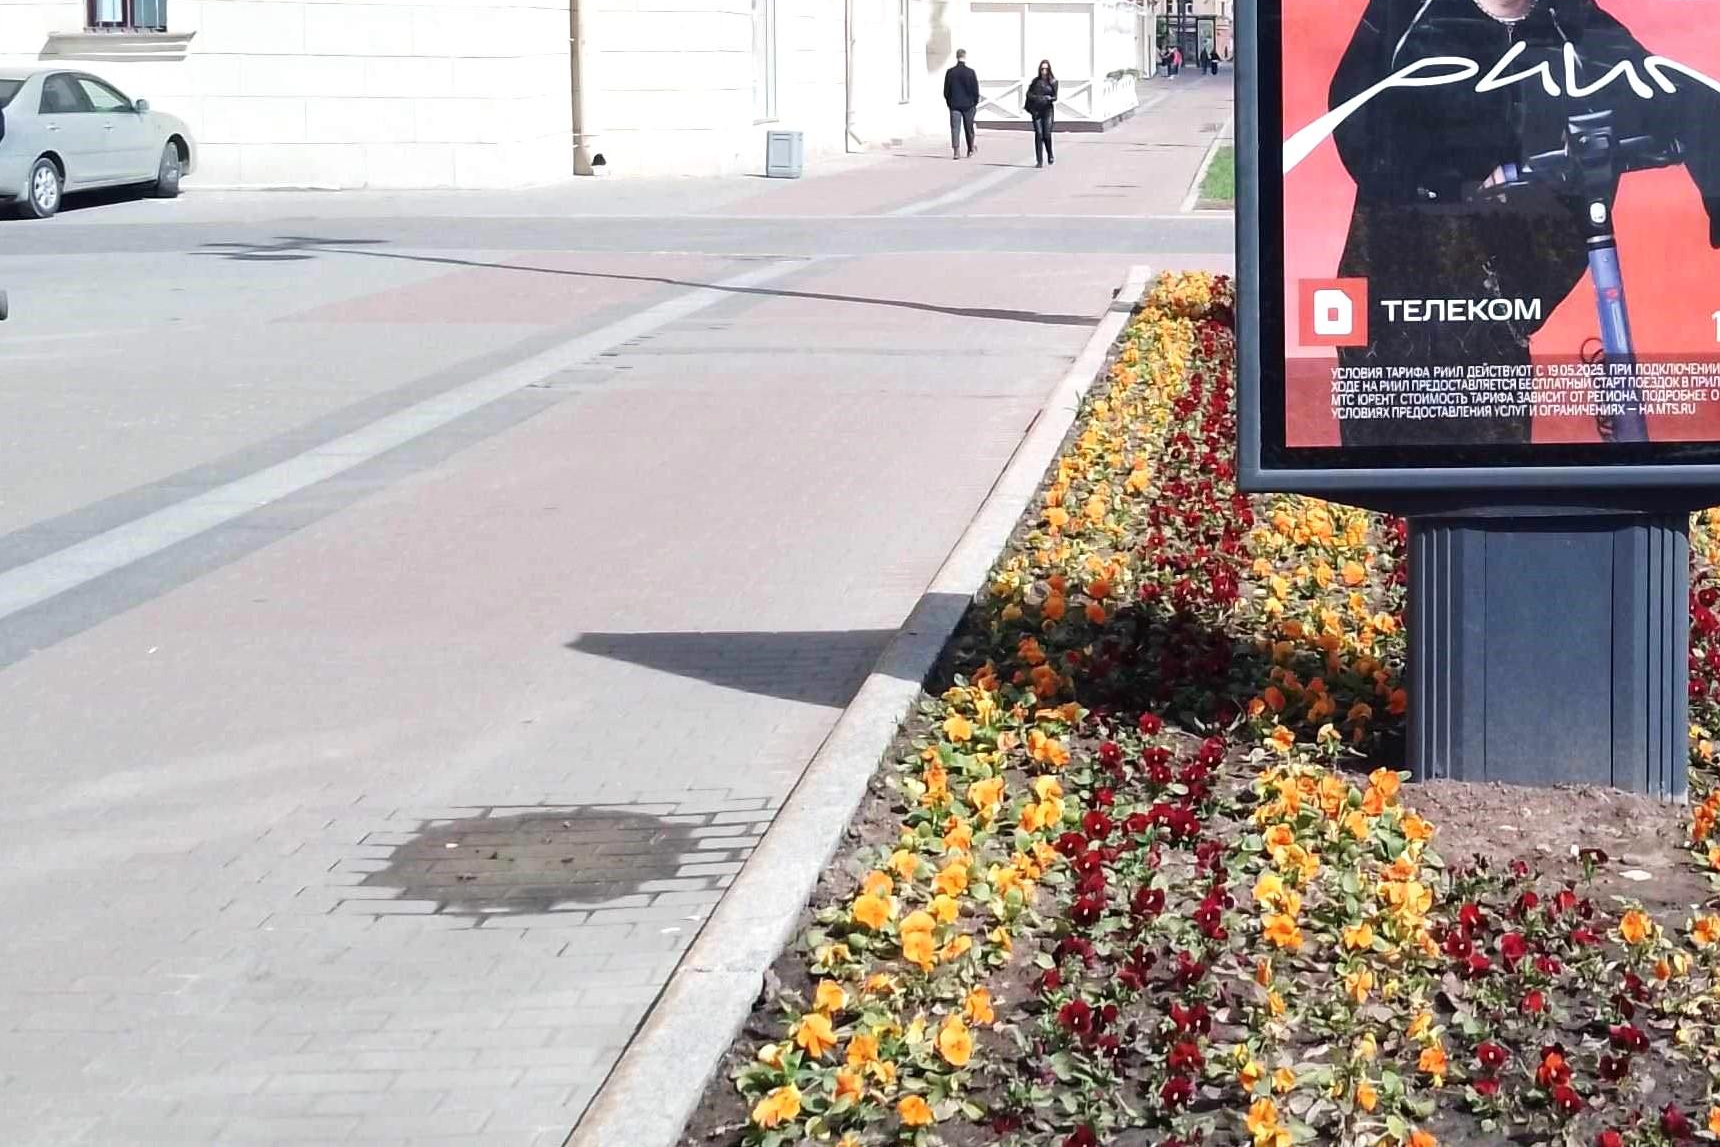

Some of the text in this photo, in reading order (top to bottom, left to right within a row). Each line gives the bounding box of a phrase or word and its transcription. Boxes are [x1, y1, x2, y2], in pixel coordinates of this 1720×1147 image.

[1381, 298, 1541, 322] ТЕЛЕКОМ
[1331, 367, 1383, 379] УСЛОВИЯ
[1386, 366, 1430, 378] ТАРИФА
[1433, 366, 1463, 378] РИИЛ
[1467, 363, 1531, 378] ДЕЙСТВУЮТ
[1536, 365, 1544, 376] С
[1610, 364, 1632, 375] ПРИ
[1636, 363, 1720, 376] ПОДКЛЮЧЕНИИ
[1331, 381, 1360, 393] ХОДЕ
[1362, 381, 1378, 392] НА
[1380, 380, 1409, 392] РИИЛ
[1412, 379, 1516, 391] ПРЕДОСТАВЛЯЕТСЯ
[1518, 377, 1591, 390] БЕСПЛАТНЫЙ
[1593, 377, 1626, 389] СТАРТ
[1628, 376, 1680, 389] ПОЕЗДОК
[1331, 394, 1355, 406] МТС
[1400, 393, 1467, 405] СТОИМОСТЬ
[1470, 392, 1513, 404] ТАРИФА
[1516, 391, 1566, 404] ЗАВИСИТ
[1570, 391, 1584, 402] ОТ
[1642, 390, 1707, 402] ПОДРОБНЕЕ
[1331, 407, 1391, 419] УСЛОВИЯХ
[1392, 406, 1491, 420] ПРЕДОСТАВЛЕНИЯ
[1493, 405, 1527, 417] УСЛУГ
[1539, 404, 1625, 417] ОГРАНИЧЕНИЯХ
[1639, 403, 1654, 415] НА
